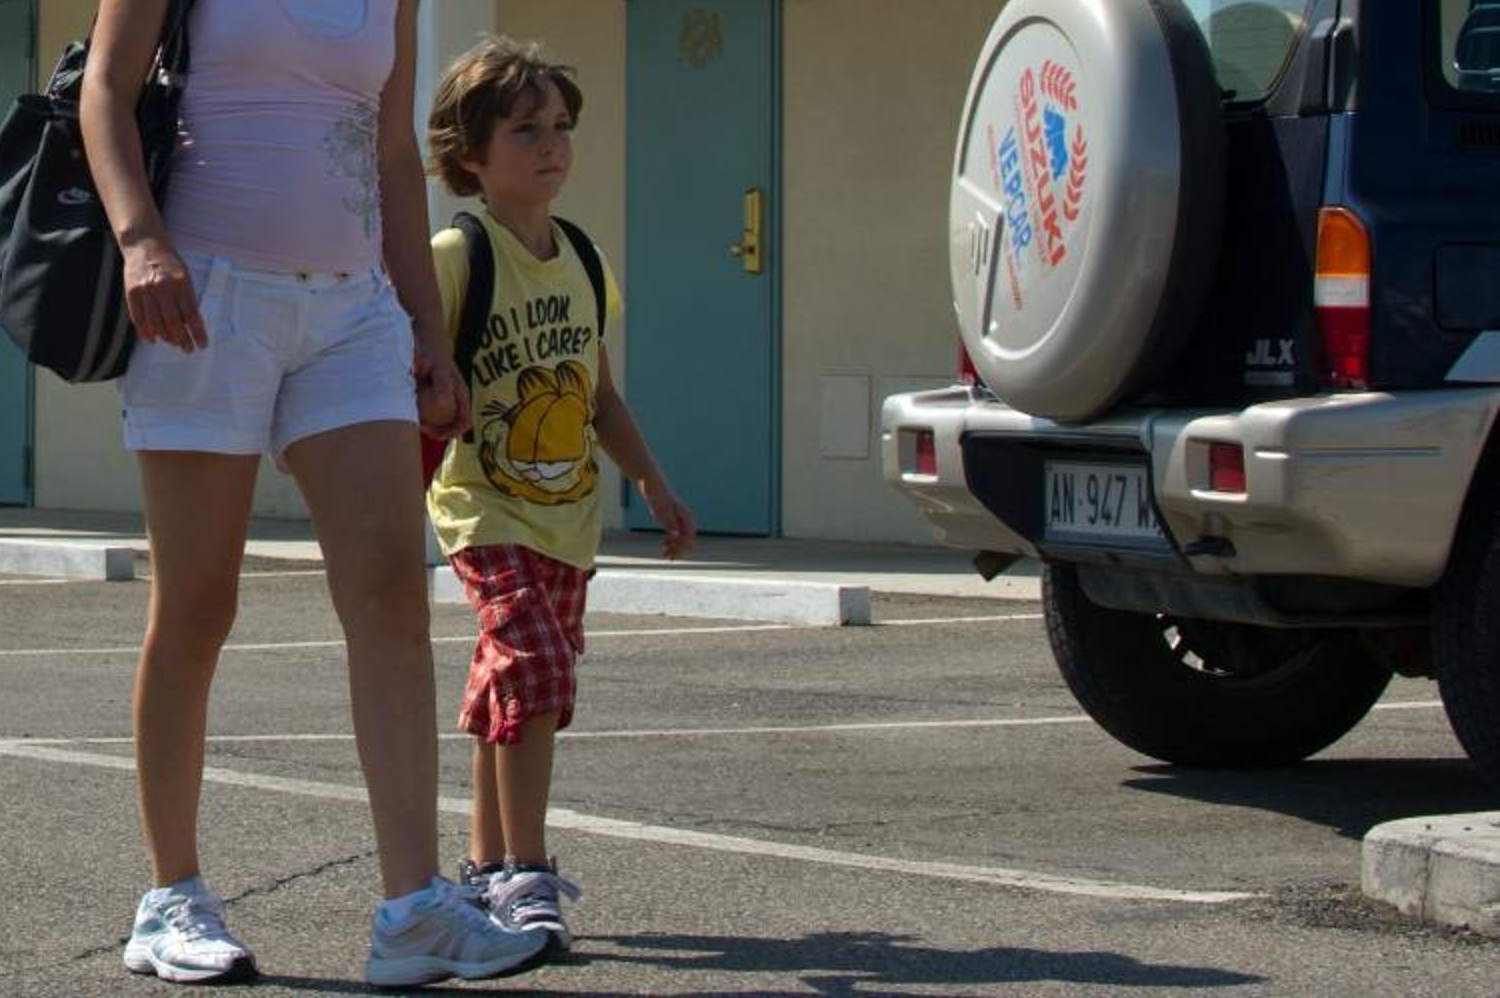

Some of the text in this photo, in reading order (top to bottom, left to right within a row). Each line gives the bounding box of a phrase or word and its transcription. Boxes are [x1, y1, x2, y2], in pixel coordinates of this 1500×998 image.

[1019, 66, 1067, 268] SUZUKI
[510, 306, 521, 335] I
[526, 294, 571, 329] LOOK
[472, 326, 592, 389] LIKE I CARE?
[1244, 337, 1297, 366] JLX
[1050, 473, 1076, 524] AN
[1086, 473, 1127, 527] 947
